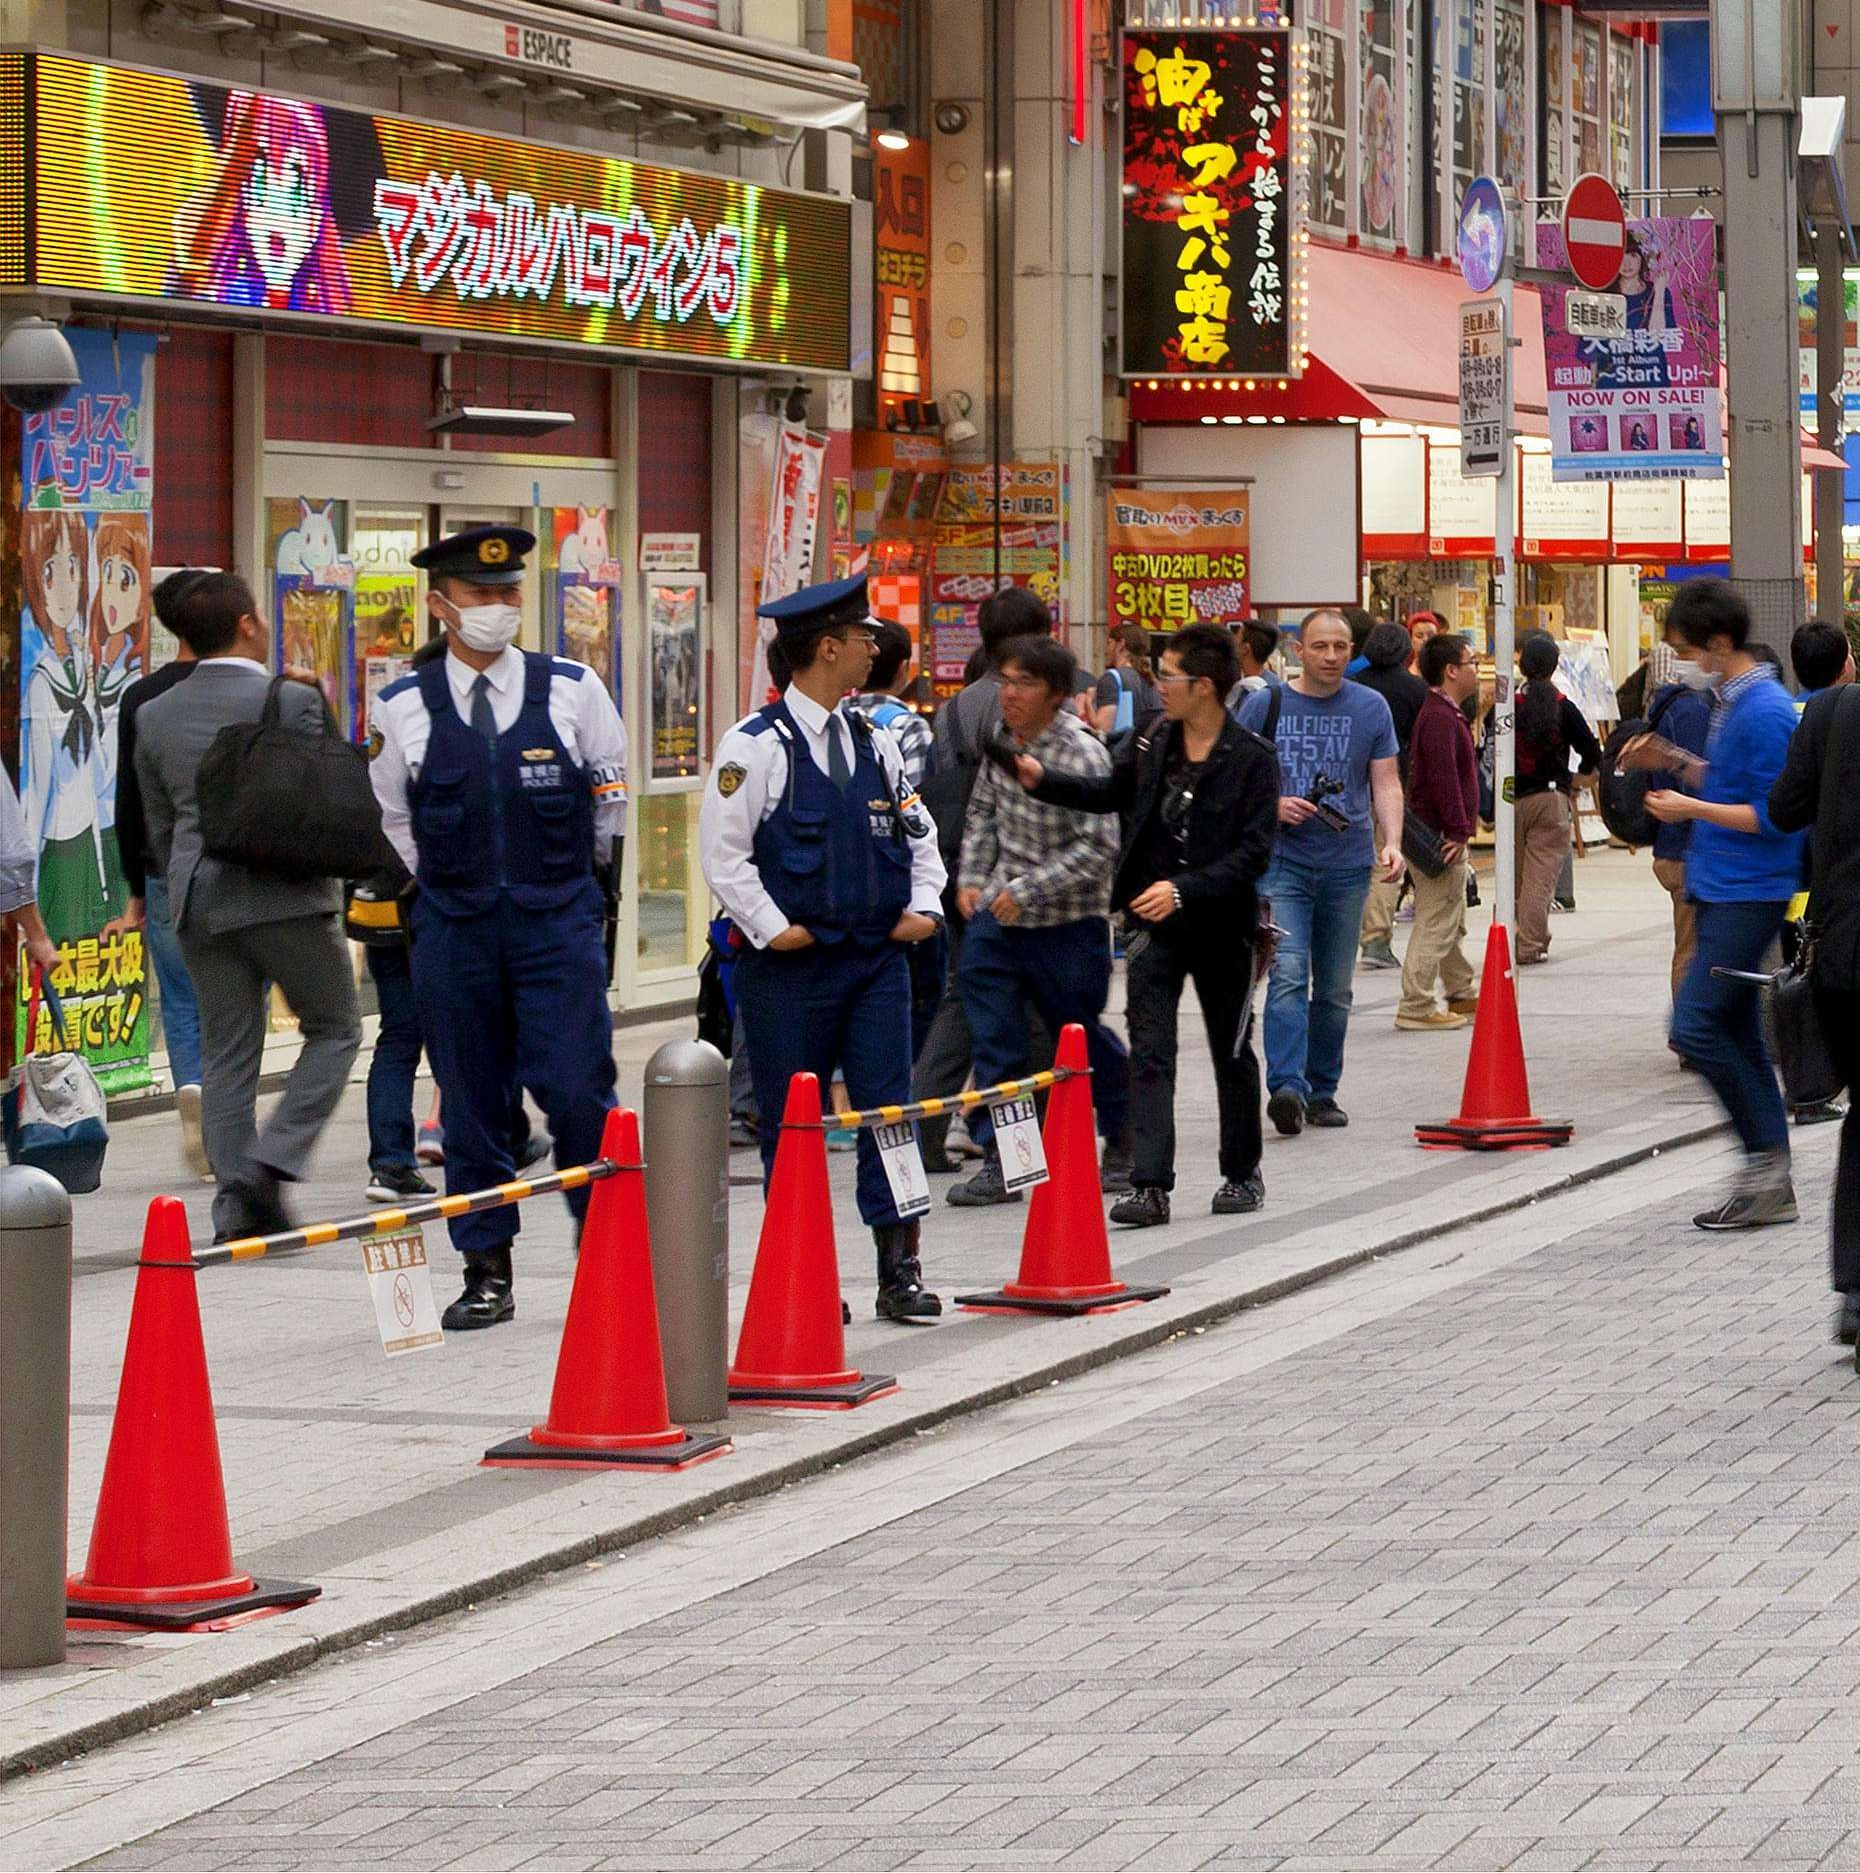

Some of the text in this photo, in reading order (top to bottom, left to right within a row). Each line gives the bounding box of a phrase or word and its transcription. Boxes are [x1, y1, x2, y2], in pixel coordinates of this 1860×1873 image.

[523, 29, 572, 69] ESPACE
[373, 169, 743, 326] マジカルハロウィン5
[1174, 142, 1238, 364] アキバ商店
[1567, 389, 1706, 407] NOW ON SALE!
[1114, 581, 1190, 619] 3枚目
[521, 775, 563, 788] POLICE
